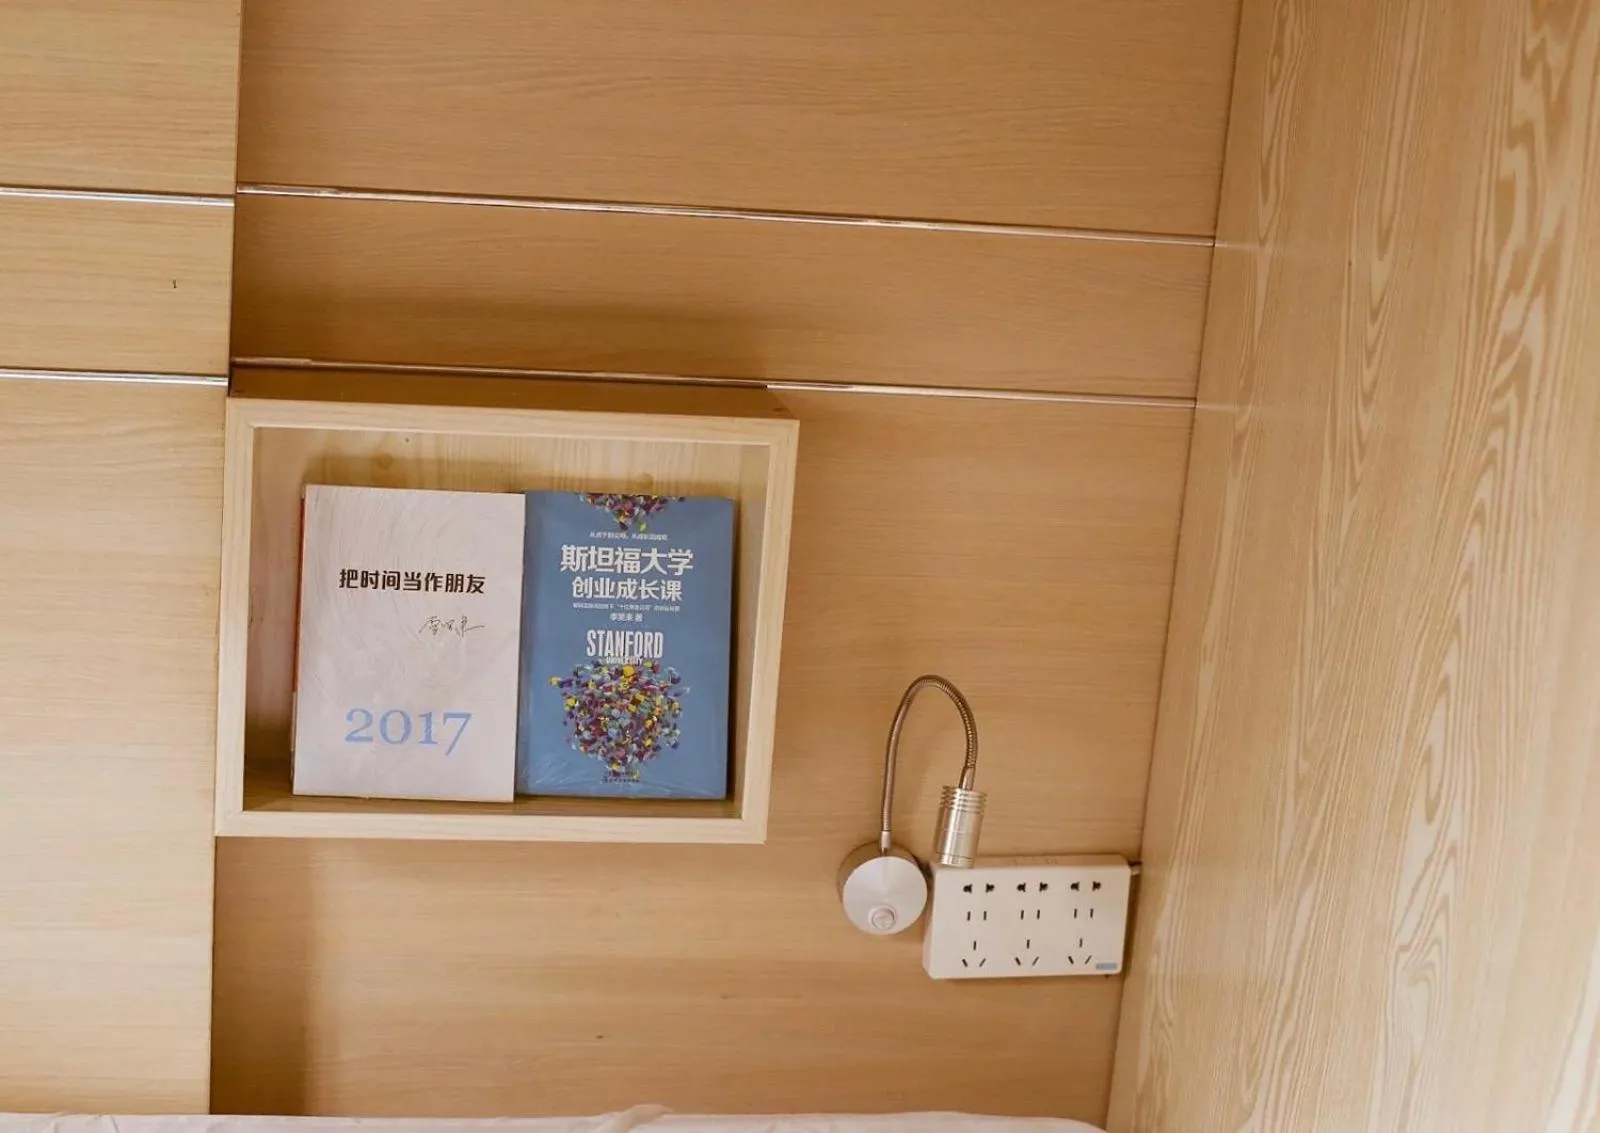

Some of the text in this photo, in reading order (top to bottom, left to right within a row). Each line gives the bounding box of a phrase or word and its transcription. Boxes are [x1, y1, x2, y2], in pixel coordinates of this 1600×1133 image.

[560, 544, 694, 575] 斯坦福大学
[339, 568, 486, 594] 把时间当作朋友
[571, 576, 682, 602] 创业成长课
[586, 629, 664, 659] STANFORD
[345, 708, 473, 756] 2017
